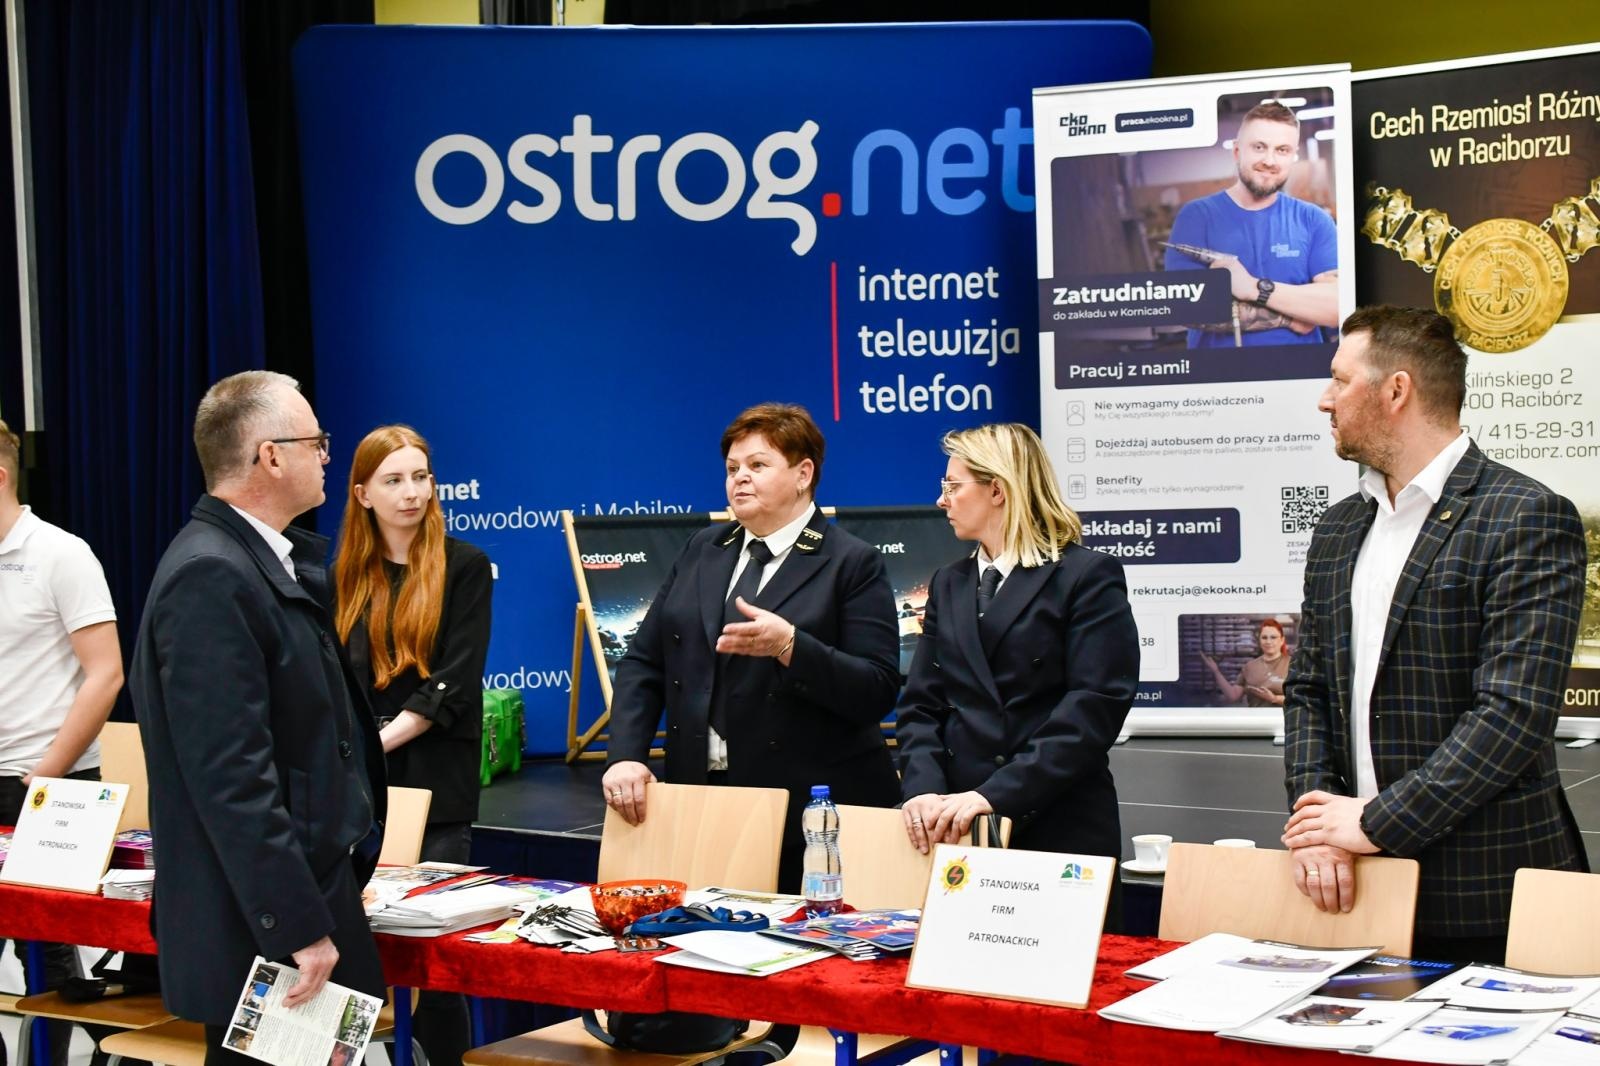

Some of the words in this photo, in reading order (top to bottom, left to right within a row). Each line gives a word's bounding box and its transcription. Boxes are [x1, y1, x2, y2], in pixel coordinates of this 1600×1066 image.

[1120, 113, 1189, 127] praca.ekookna.pl
[1370, 108, 1424, 140] Cech
[1431, 95, 1532, 133] Rzemiosł
[1429, 146, 1452, 168] w
[1458, 133, 1571, 166] Raciborzu
[414, 108, 1034, 256] ostrog.net
[858, 266, 1000, 303] internet
[1053, 280, 1205, 305] Zatrudniamy
[1053, 311, 1067, 321] do
[1067, 308, 1107, 320] zakładu
[1108, 309, 1118, 317] w
[1120, 305, 1171, 317] Kornicach
[858, 318, 1021, 367] telewizja
[1069, 362, 1124, 380] Pracuj
[1127, 364, 1138, 376] z
[1141, 359, 1191, 375] nami!
[1560, 367, 1573, 385] 2
[859, 374, 993, 414] telefon
[1094, 401, 1112, 410] Nie
[1115, 399, 1180, 411] wymagamy
[1182, 394, 1265, 408] doświadczenia
[1501, 390, 1583, 408] Racibórz
[1151, 434, 1214, 447] autobusem
[1216, 433, 1231, 444] do
[1234, 432, 1264, 446] pracy
[1268, 433, 1280, 443] za
[1283, 430, 1321, 442] darmo
[1488, 420, 1594, 440] 415-29-31
[1096, 475, 1143, 486] Benefity
[1156, 522, 1168, 534] z
[1172, 517, 1222, 534] nami
[581, 551, 647, 566] ostrog.net
[1133, 585, 1267, 597] rekrutacja@ekookna.pl
[1141, 638, 1155, 647] 38
[979, 878, 1040, 891] STANOWISKA
[991, 905, 1015, 915] FIRM
[968, 932, 1040, 947] PATRONACKICH
